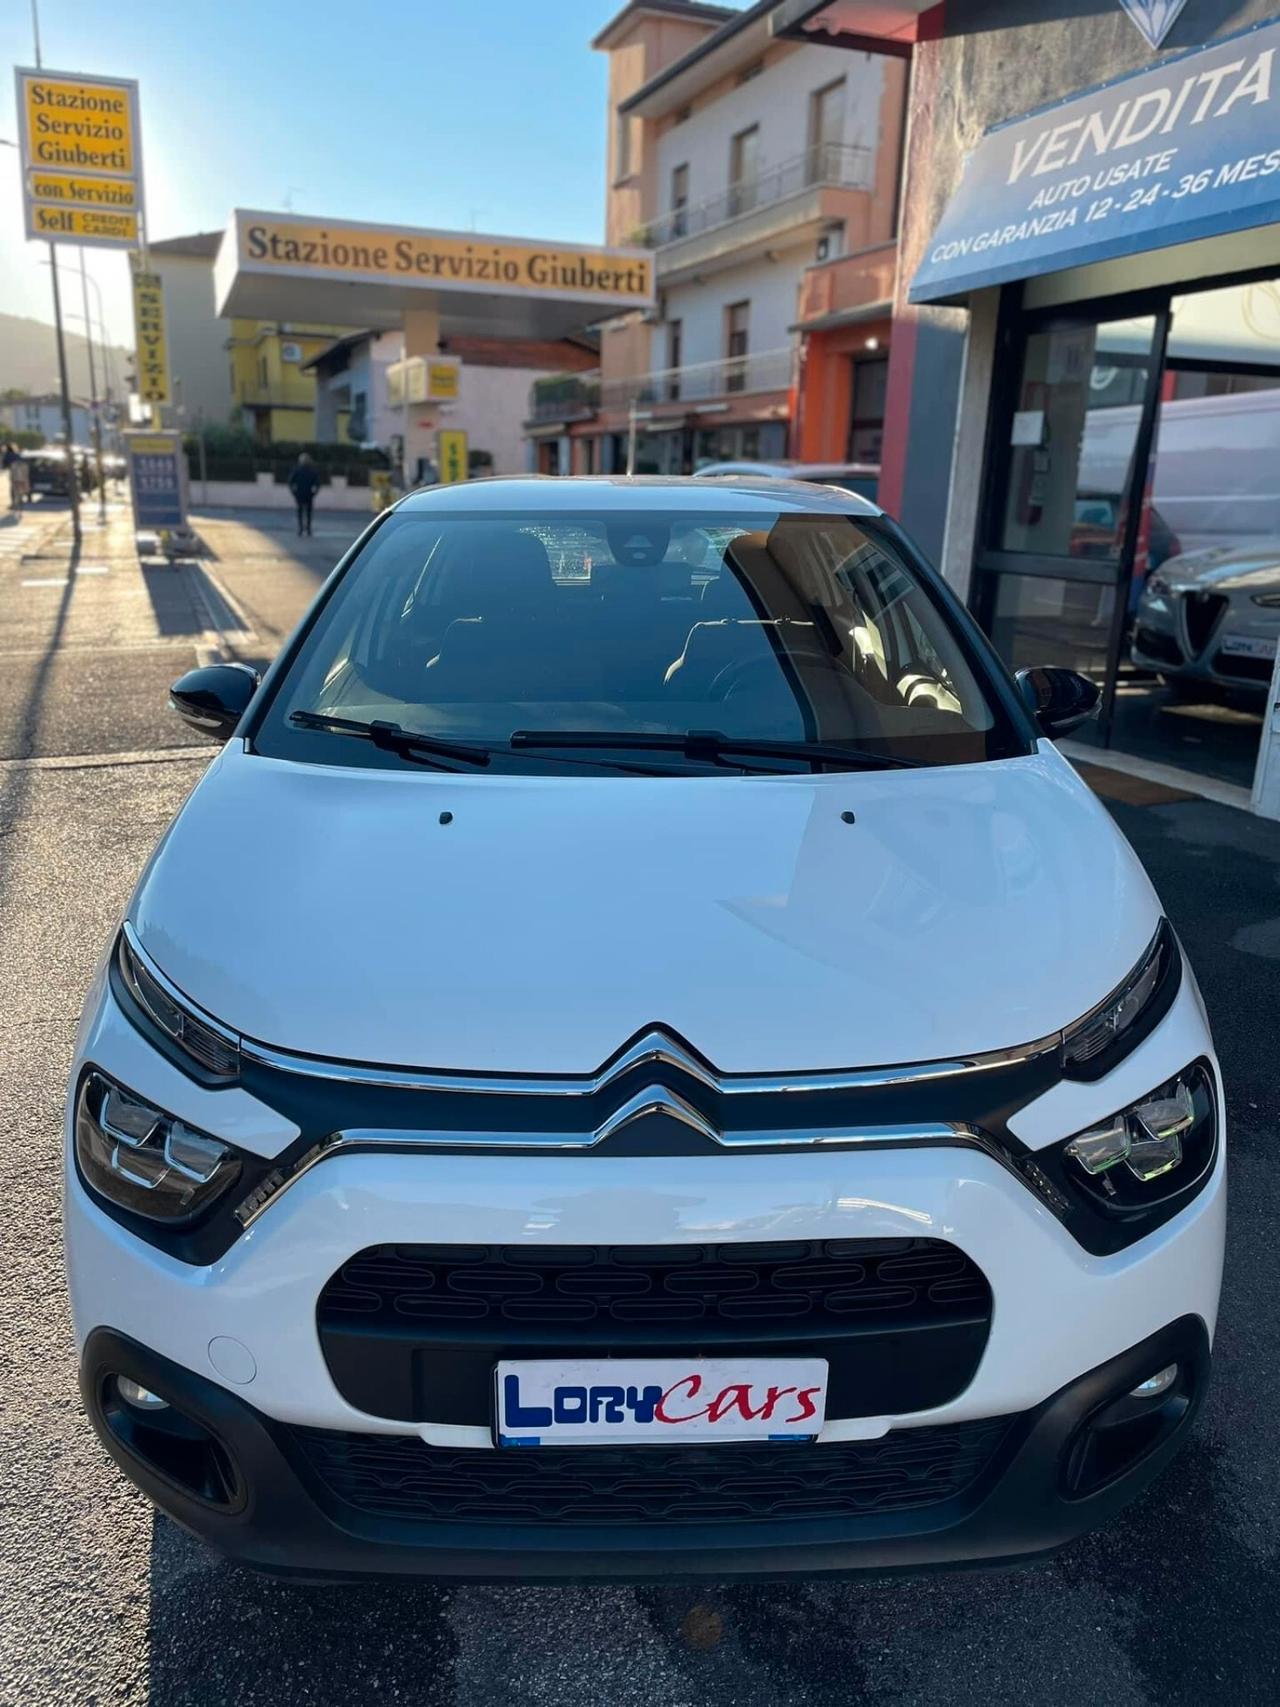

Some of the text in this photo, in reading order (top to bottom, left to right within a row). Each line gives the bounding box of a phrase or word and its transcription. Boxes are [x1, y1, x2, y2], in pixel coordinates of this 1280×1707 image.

[32, 84, 123, 113] Stazione
[1006, 48, 1276, 185] VENDITA
[36, 113, 123, 140] Servizio
[38, 141, 125, 168] Giuberti
[35, 181, 133, 205] con Servizio
[1027, 148, 1179, 210] AUTO USATE
[931, 236, 973, 264] CON
[972, 207, 1078, 252] GARANZIA
[1212, 148, 1280, 188] MES
[248, 226, 646, 294] Stazione Servizio Giuberti
